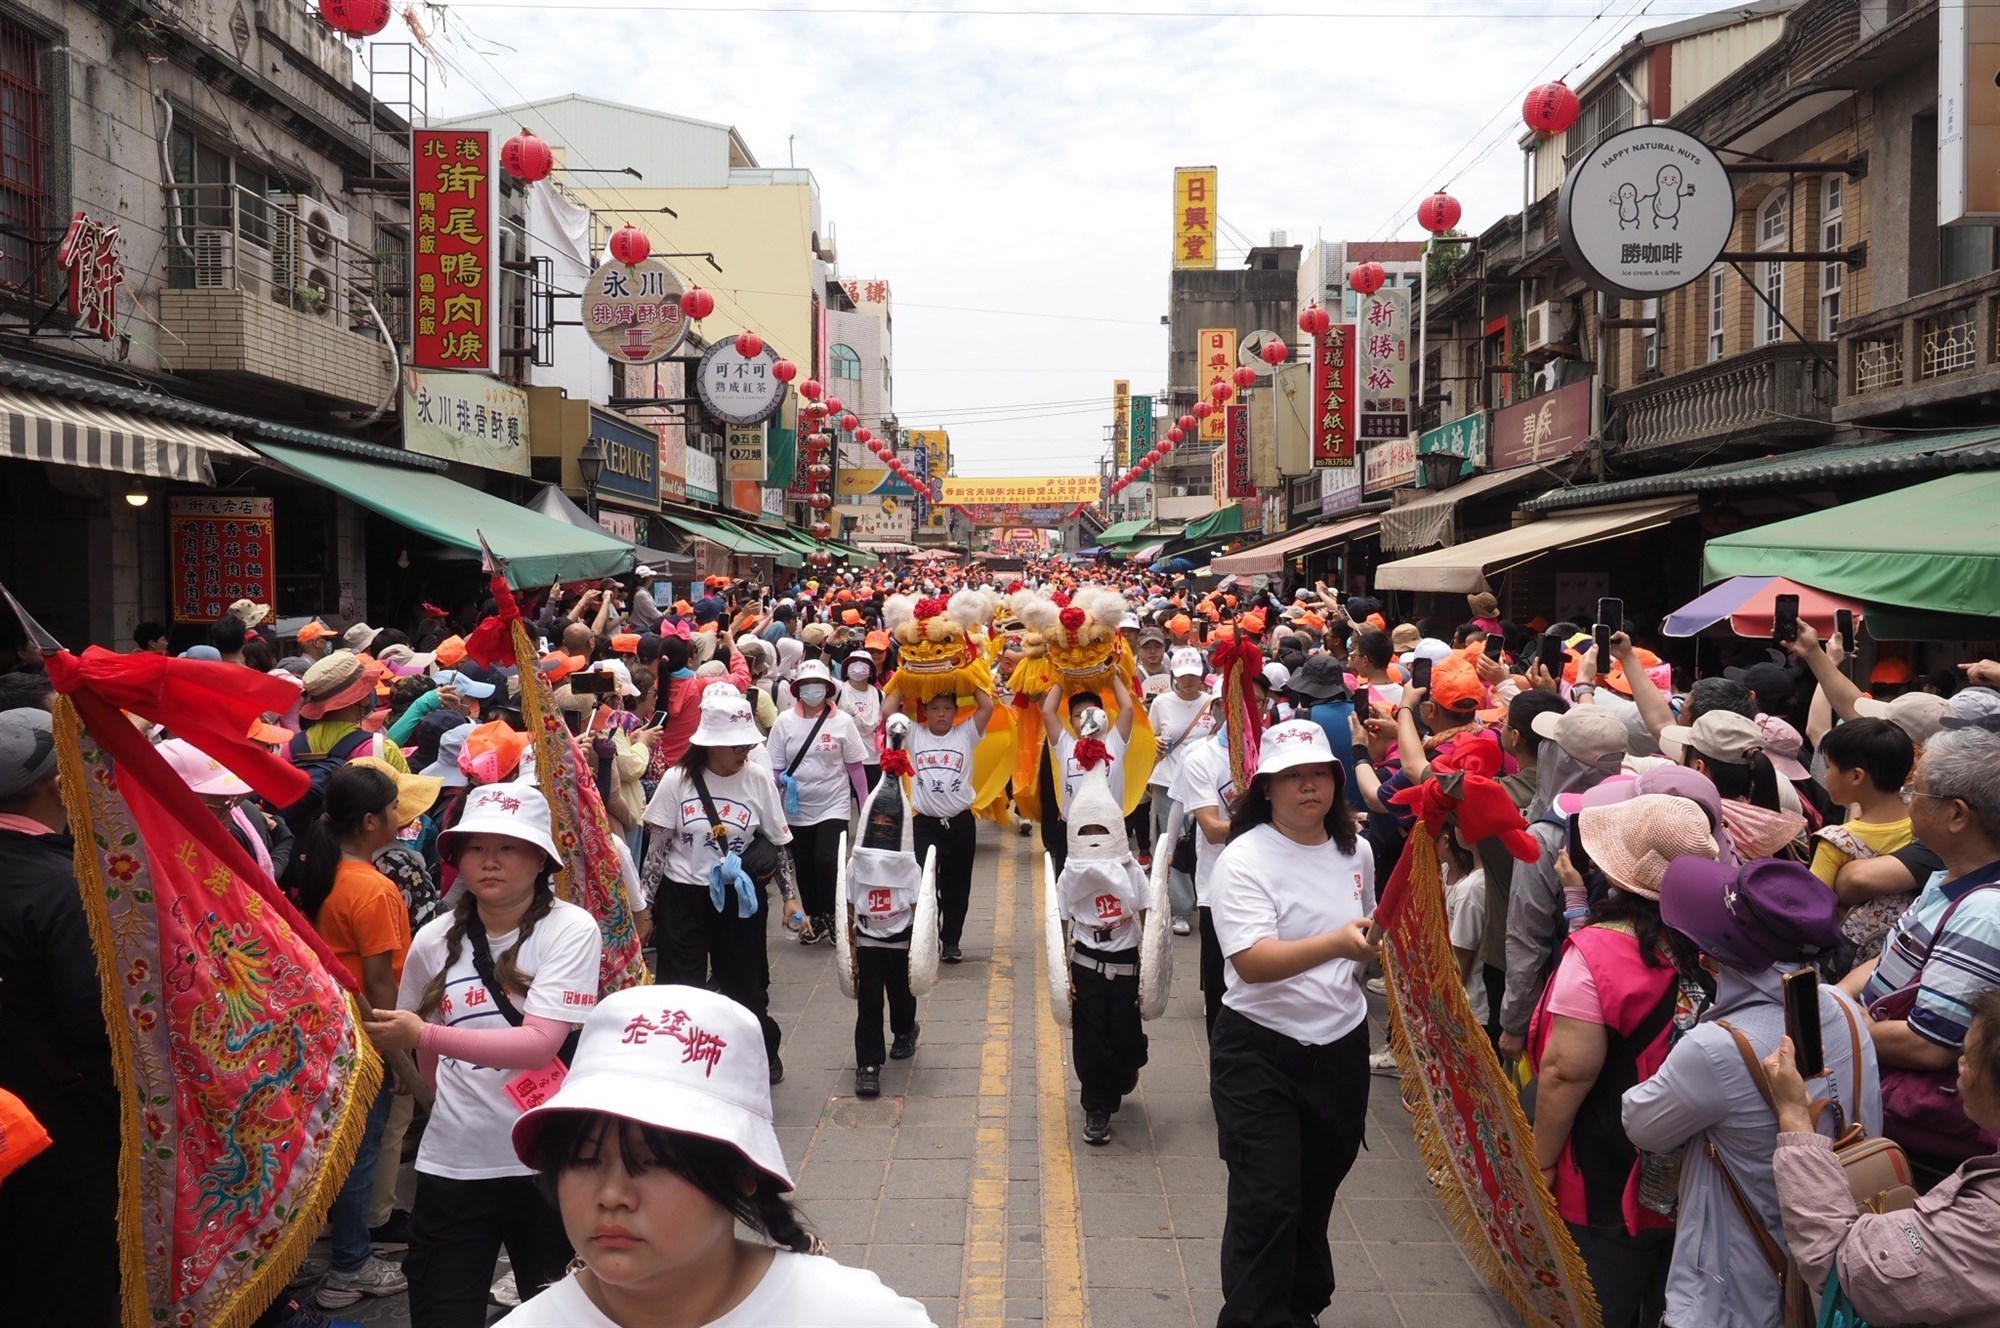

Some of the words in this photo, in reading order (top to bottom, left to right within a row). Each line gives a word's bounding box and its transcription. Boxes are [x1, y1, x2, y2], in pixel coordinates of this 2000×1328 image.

[423, 138, 482, 160] 北港
[1601, 147, 1630, 169] HAPPY
[1632, 142, 1675, 153] NATURAL
[1677, 148, 1702, 166] NUTS
[418, 191, 436, 254] 鴨肉飯
[1183, 177, 1208, 259] 日興堂
[1621, 242, 1683, 264] 勝咖啡
[603, 271, 664, 298] 永川
[418, 273, 436, 336] 魯肉飯
[592, 303, 680, 324] 排骨酥麵
[1367, 300, 1395, 390] 新勝裕
[716, 362, 767, 379] 可不可
[715, 382, 767, 394] 熟成紅茶
[1322, 326, 1346, 454] 鑫瑞益金紙行
[418, 386, 520, 447] 永川排骨酥麵
[740, 433, 761, 444] 五金
[600, 437, 652, 482] KEBUKE
[740, 449, 762, 460] 刀類
[188, 499, 253, 515] 街尾老店
[1276, 728, 1314, 745] 老塗獅
[476, 791, 523, 816] 老塗獅
[622, 1009, 727, 1079] 老塗獅
